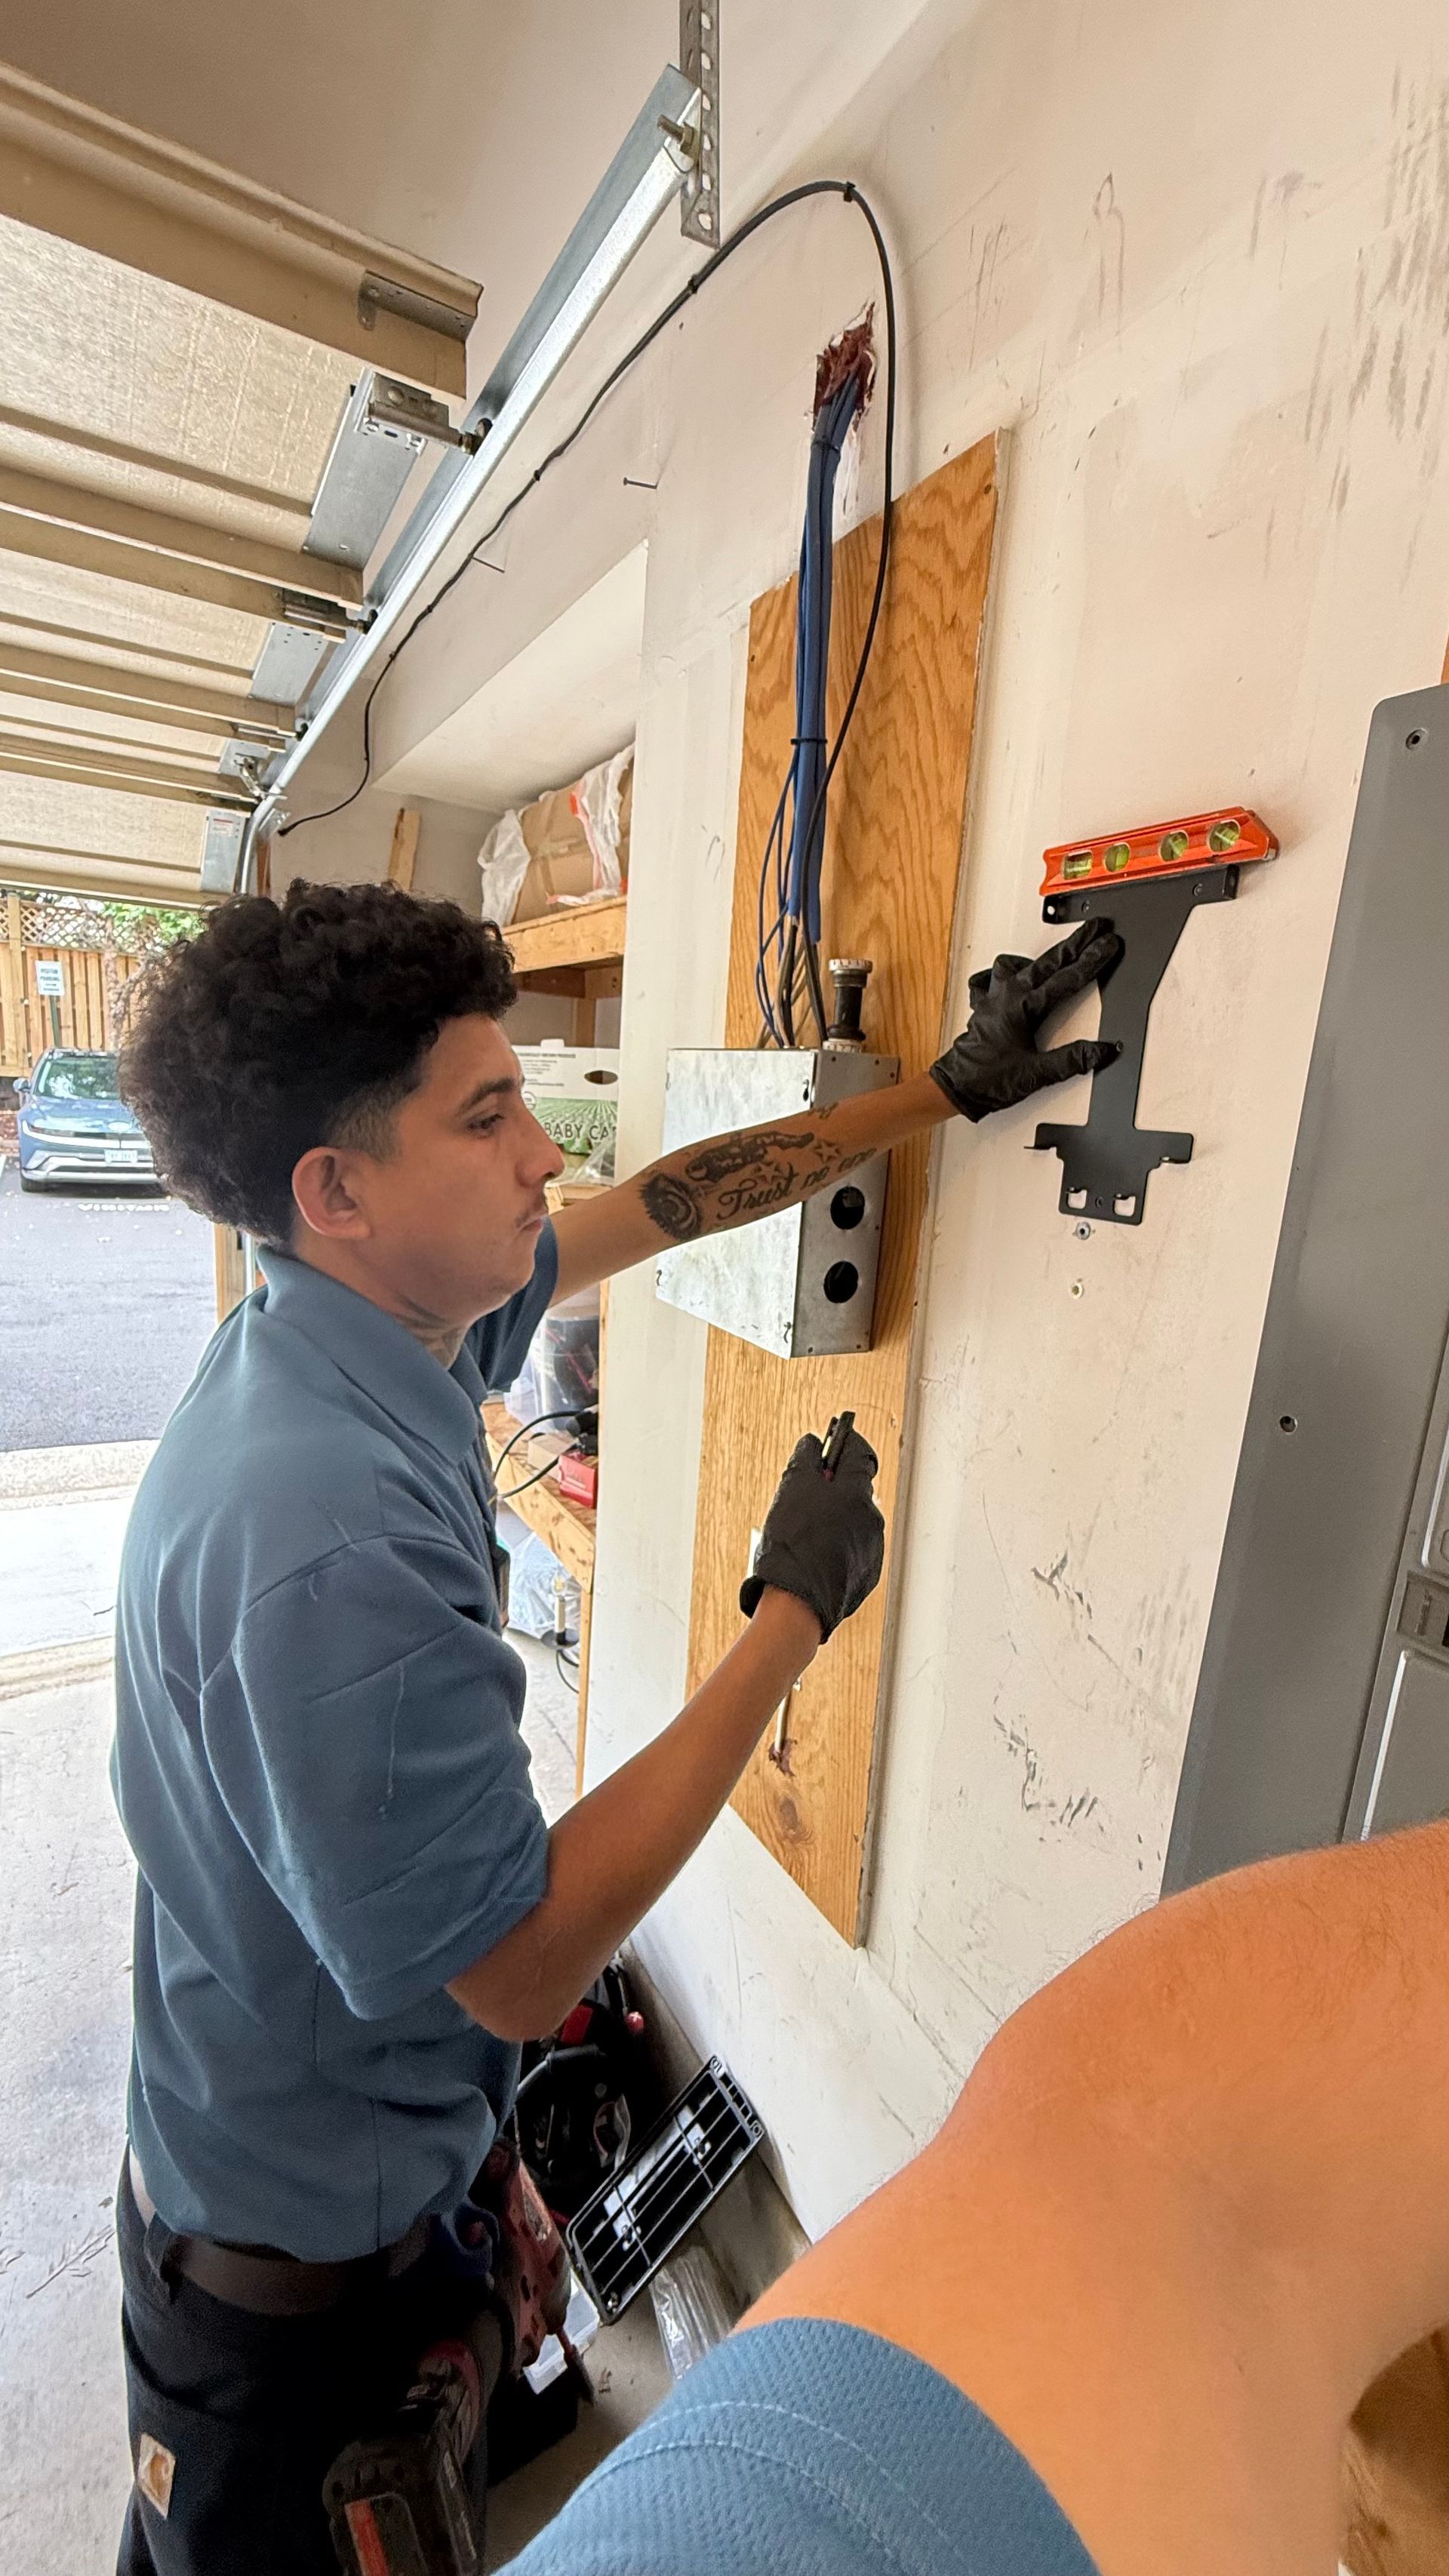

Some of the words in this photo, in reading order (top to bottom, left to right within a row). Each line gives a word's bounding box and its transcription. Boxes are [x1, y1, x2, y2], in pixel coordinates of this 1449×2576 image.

[543, 1122, 583, 1139] BABY
[589, 1125, 617, 1141] CA
[717, 1162, 800, 1220] Trust
[800, 1165, 831, 1191] no
